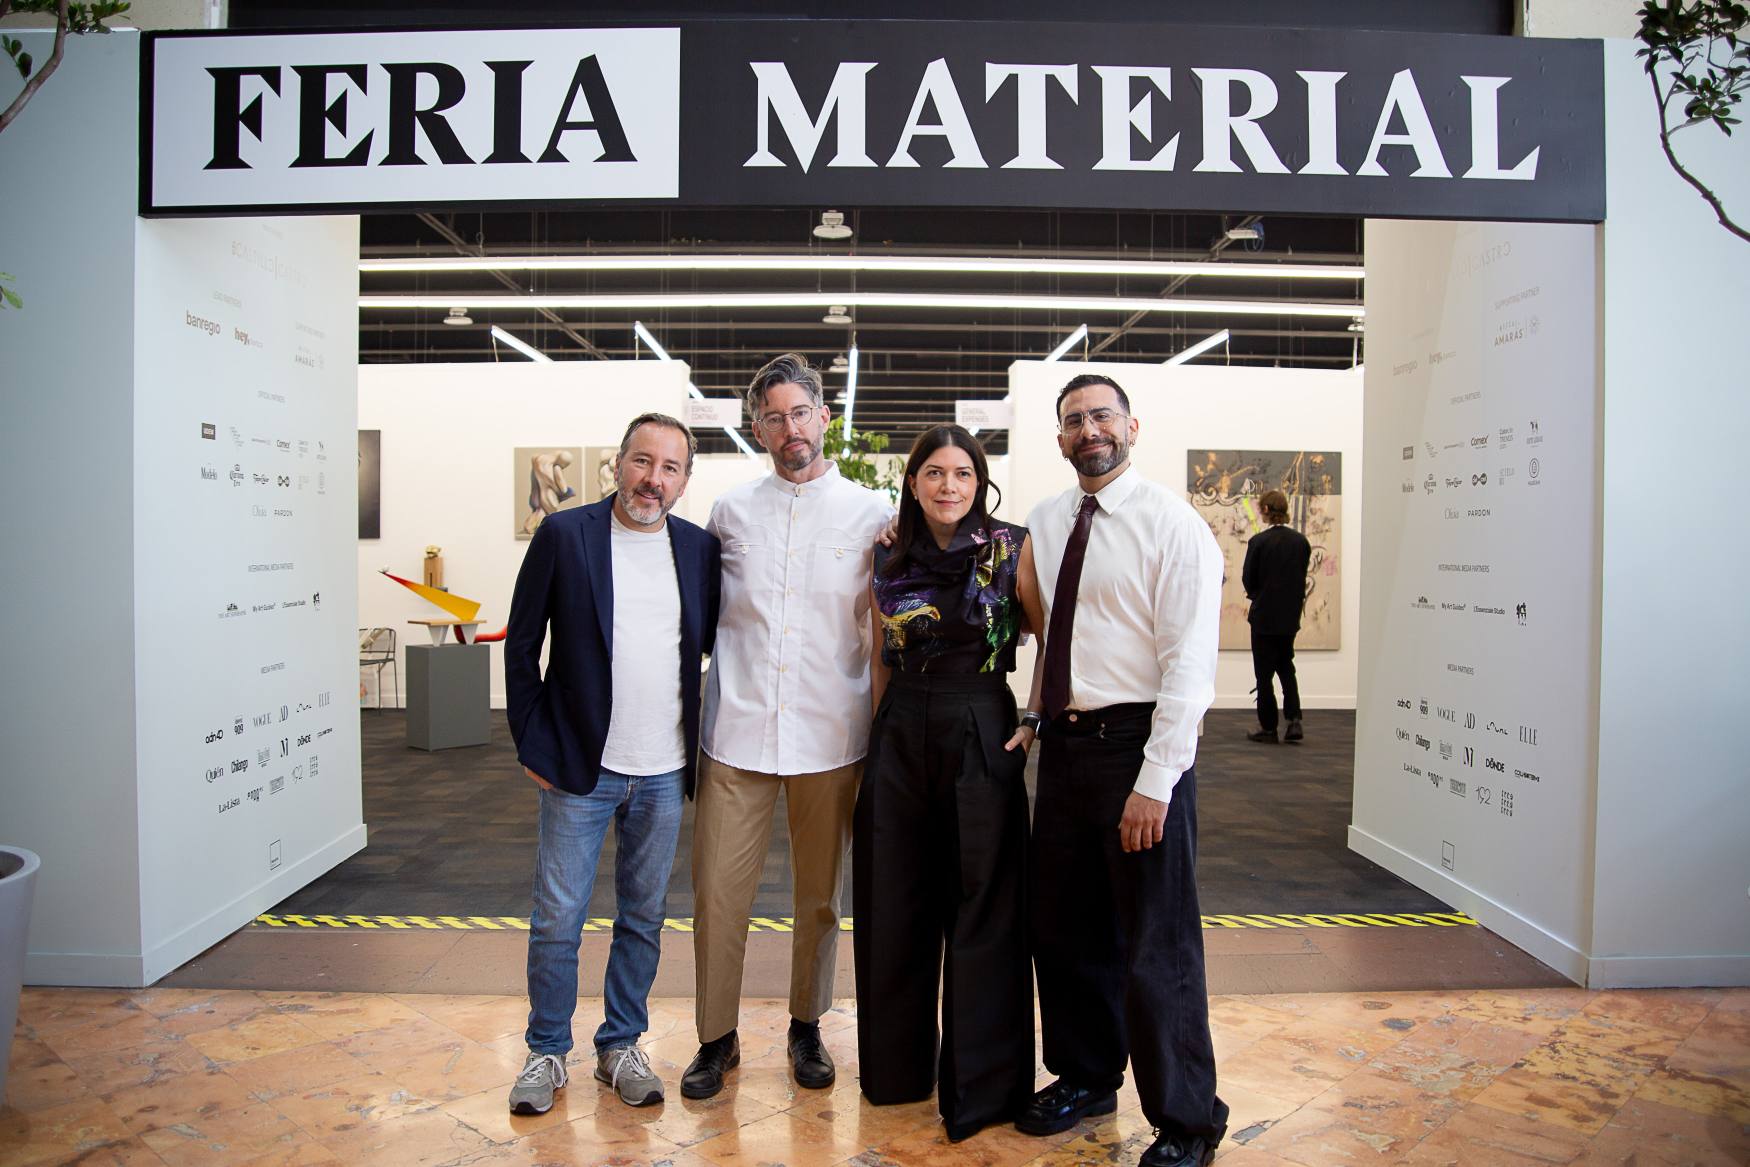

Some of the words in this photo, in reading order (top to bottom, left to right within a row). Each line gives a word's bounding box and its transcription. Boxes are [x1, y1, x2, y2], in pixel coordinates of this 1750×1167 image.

[203, 53, 638, 170] FERIA
[742, 57, 1540, 181] MATERIAL
[186, 309, 221, 336] banregio
[1471, 433, 1489, 446] Comex
[1468, 508, 1490, 517] PARDON
[1464, 712, 1475, 729] AD
[1519, 725, 1537, 746] ELLE
